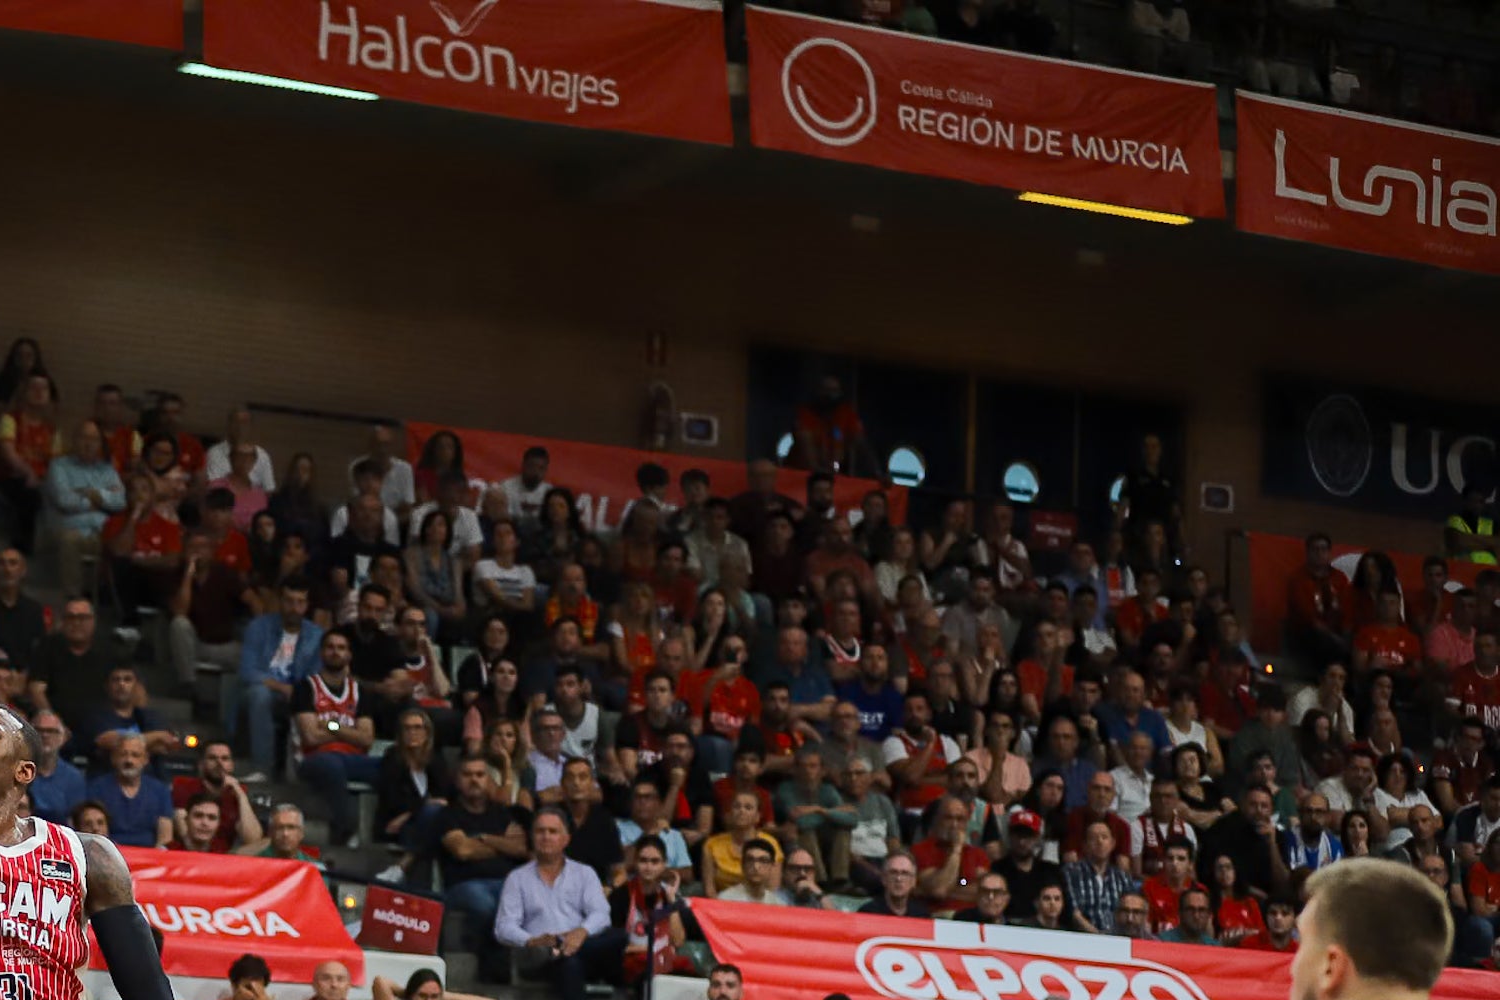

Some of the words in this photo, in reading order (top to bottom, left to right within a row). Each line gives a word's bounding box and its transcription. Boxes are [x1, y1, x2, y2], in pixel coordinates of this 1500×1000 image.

[519, 65, 620, 113] viajes
[897, 104, 1015, 151] REGIÓN
[1024, 124, 1064, 157] DE
[1071, 133, 1189, 175] MURCIA
[1274, 128, 1498, 237] Lunia
[144, 902, 301, 939] URCIA
[372, 908, 431, 934] MÓDULO
